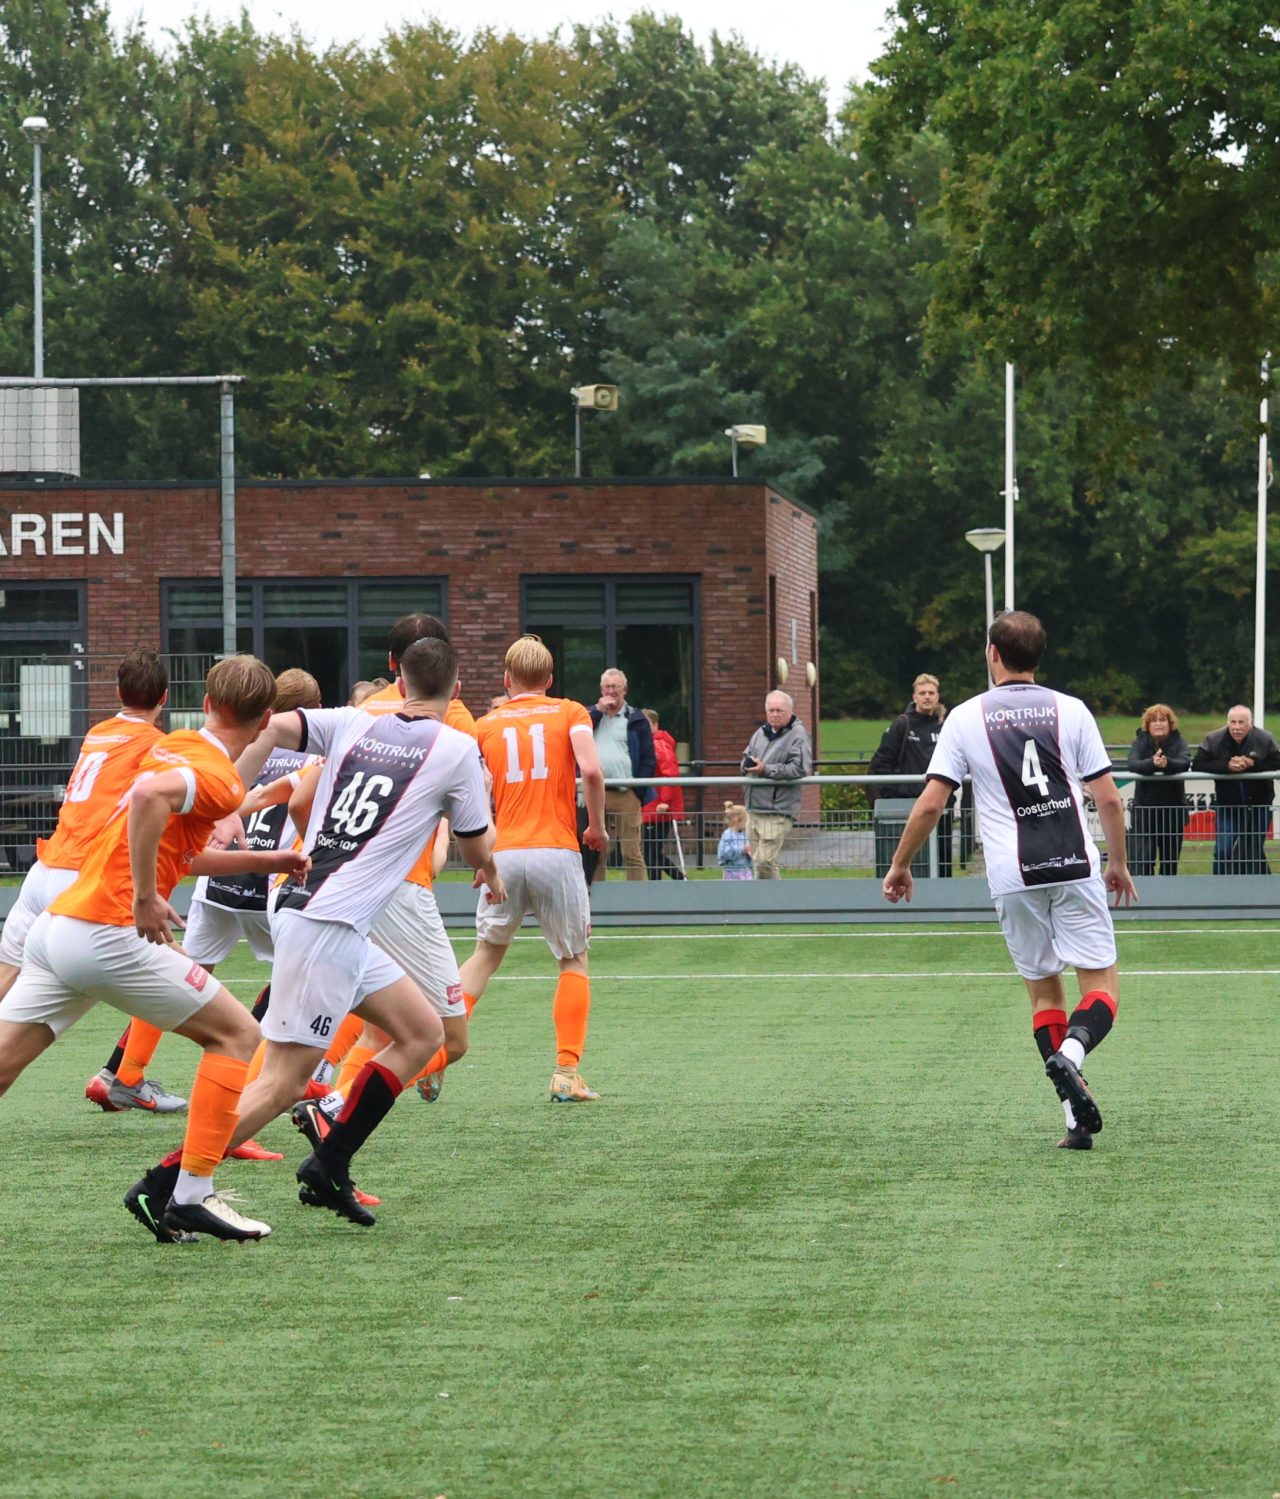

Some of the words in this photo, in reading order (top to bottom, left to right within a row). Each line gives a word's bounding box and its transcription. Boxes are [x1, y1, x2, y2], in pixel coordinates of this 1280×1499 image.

[985, 706, 1056, 723] KORTRIJK
[356, 736, 427, 760] KORTRIJK
[502, 723, 549, 784] 11
[1021, 739, 1049, 796] 4
[62, 752, 108, 806] 0
[331, 771, 394, 836] 46
[1017, 797, 1072, 817] Oosterhoff
[310, 1015, 332, 1036] 46
